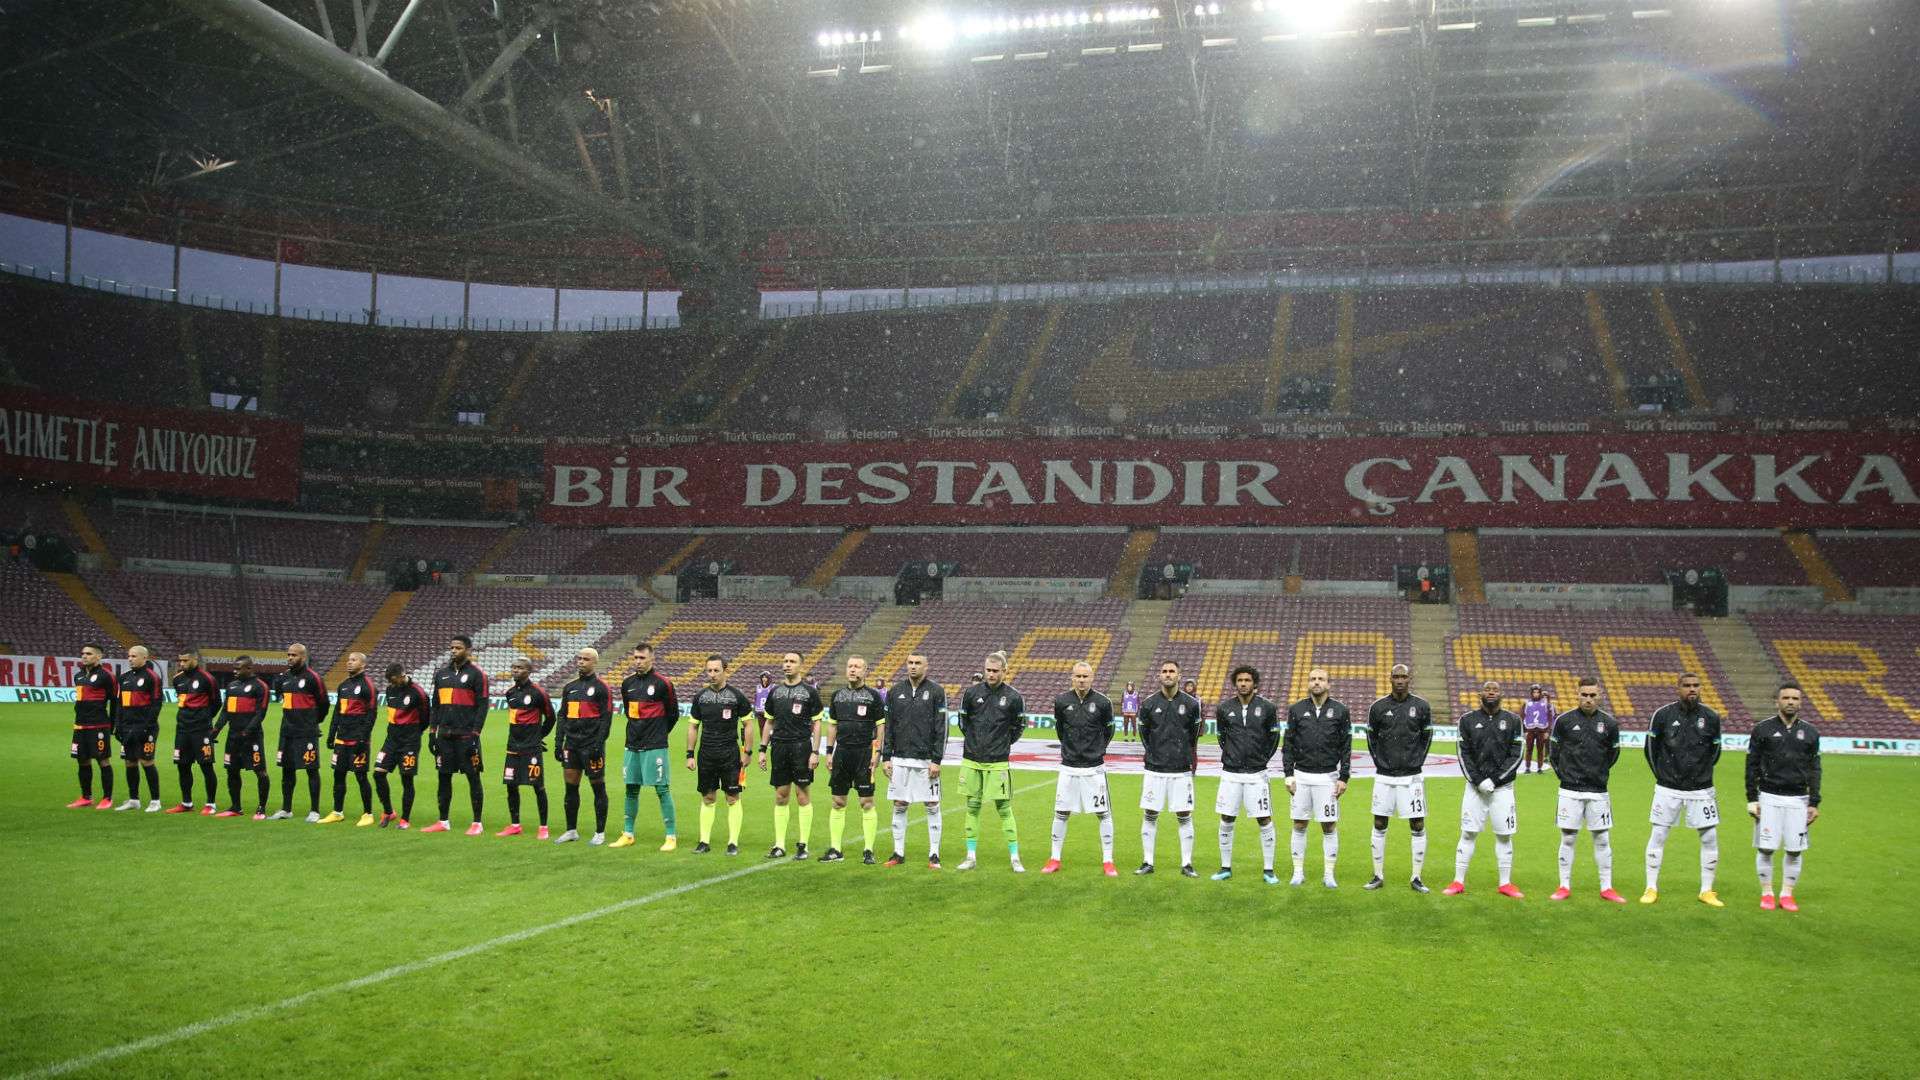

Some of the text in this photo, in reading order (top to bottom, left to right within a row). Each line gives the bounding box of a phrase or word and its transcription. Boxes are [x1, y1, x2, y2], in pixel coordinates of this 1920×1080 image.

[0, 407, 257, 479] AHMETLE ANIYORUZ
[550, 452, 1920, 516] BİR DESTANDIR ÇANAKKA
[604, 620, 1920, 725] GALATASAR
[16, 688, 51, 703] HDI
[1533, 710, 1540, 723] 2
[97, 739, 105, 751] 9
[143, 742, 154, 753] 89
[252, 752, 260, 763] 6
[303, 752, 316, 763] 45
[403, 755, 416, 767] 36
[527, 765, 540, 777] 70
[929, 783, 940, 796] 17
[1000, 783, 1006, 795] 1
[1093, 795, 1105, 808] 24
[1257, 798, 1269, 811] 15
[1410, 799, 1422, 813] 13
[1601, 812, 1611, 826] 11
[1703, 805, 1717, 820] 99
[1506, 815, 1515, 829] 19
